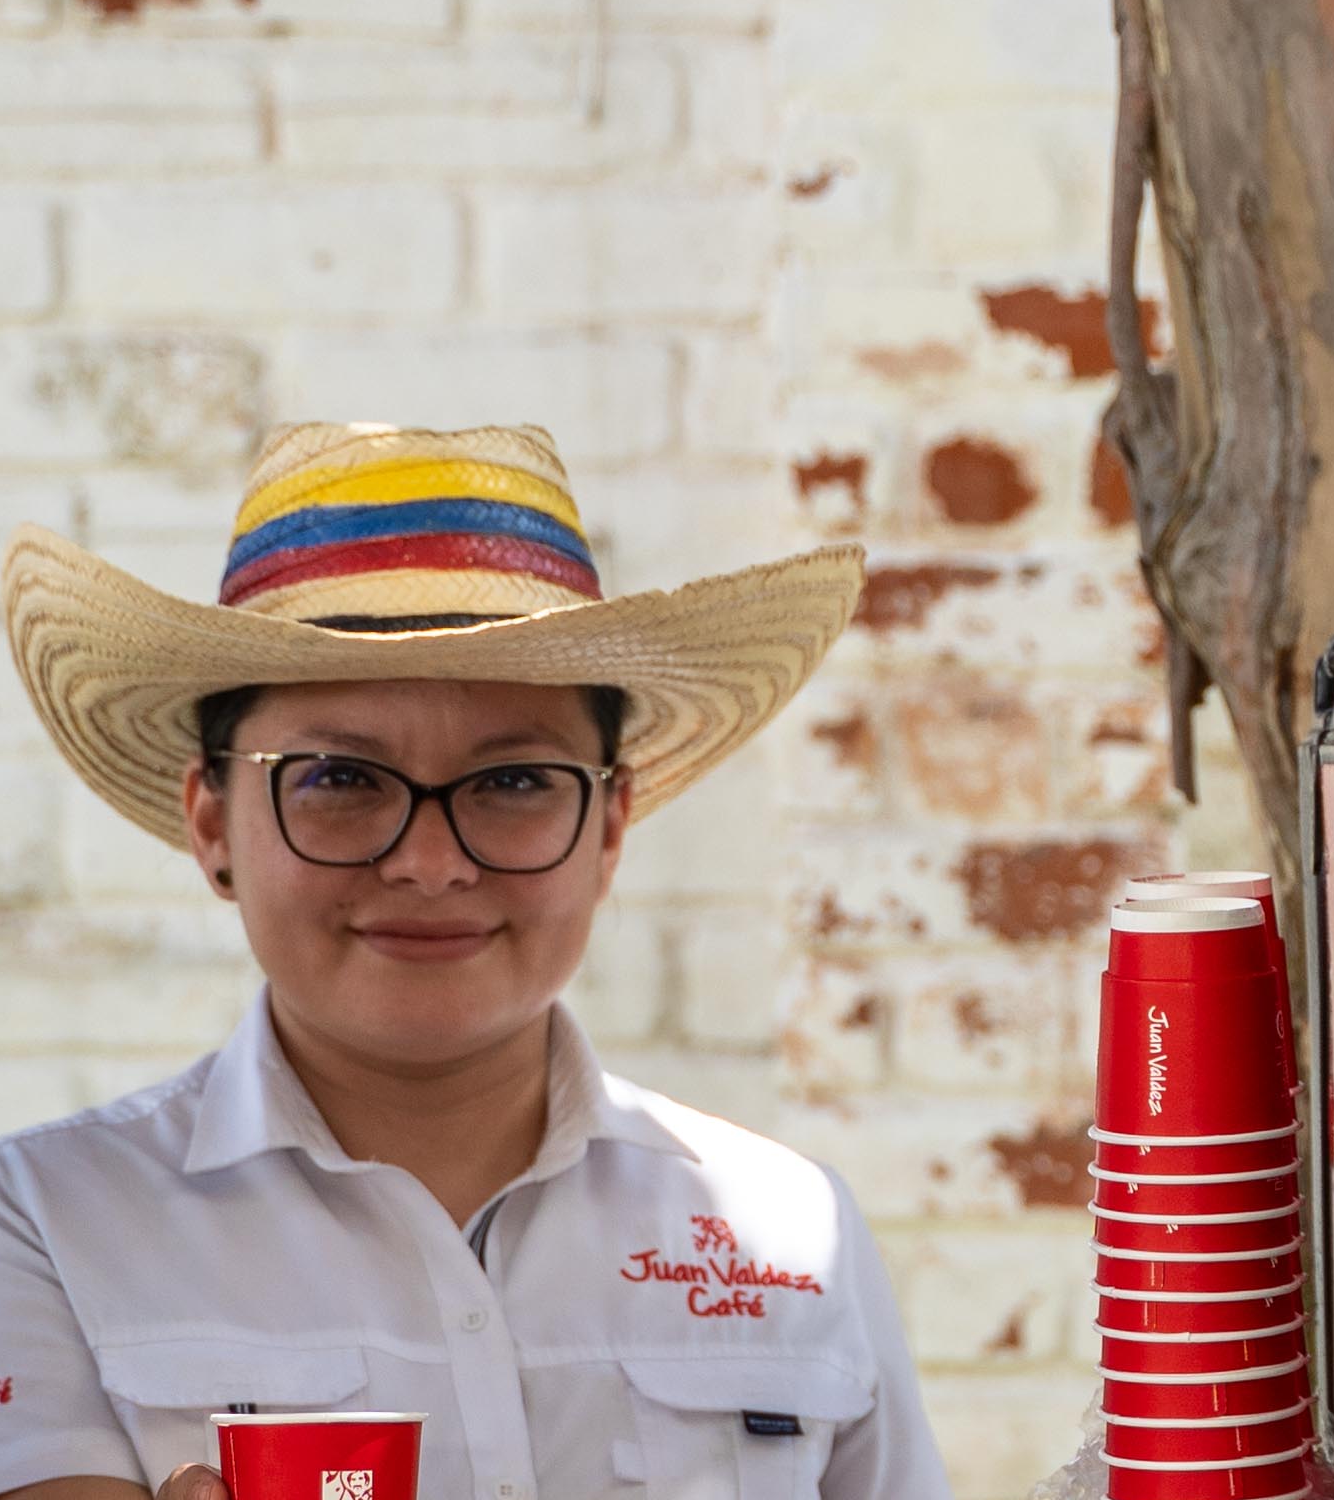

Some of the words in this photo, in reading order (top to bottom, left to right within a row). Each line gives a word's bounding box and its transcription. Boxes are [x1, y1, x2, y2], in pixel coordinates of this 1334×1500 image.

[1148, 1005, 1170, 1054] Juan
[1148, 1055, 1168, 1117] Valdez
[620, 1249, 709, 1284] Juan
[708, 1257, 819, 1295] Valdez
[686, 1285, 765, 1318] Café
